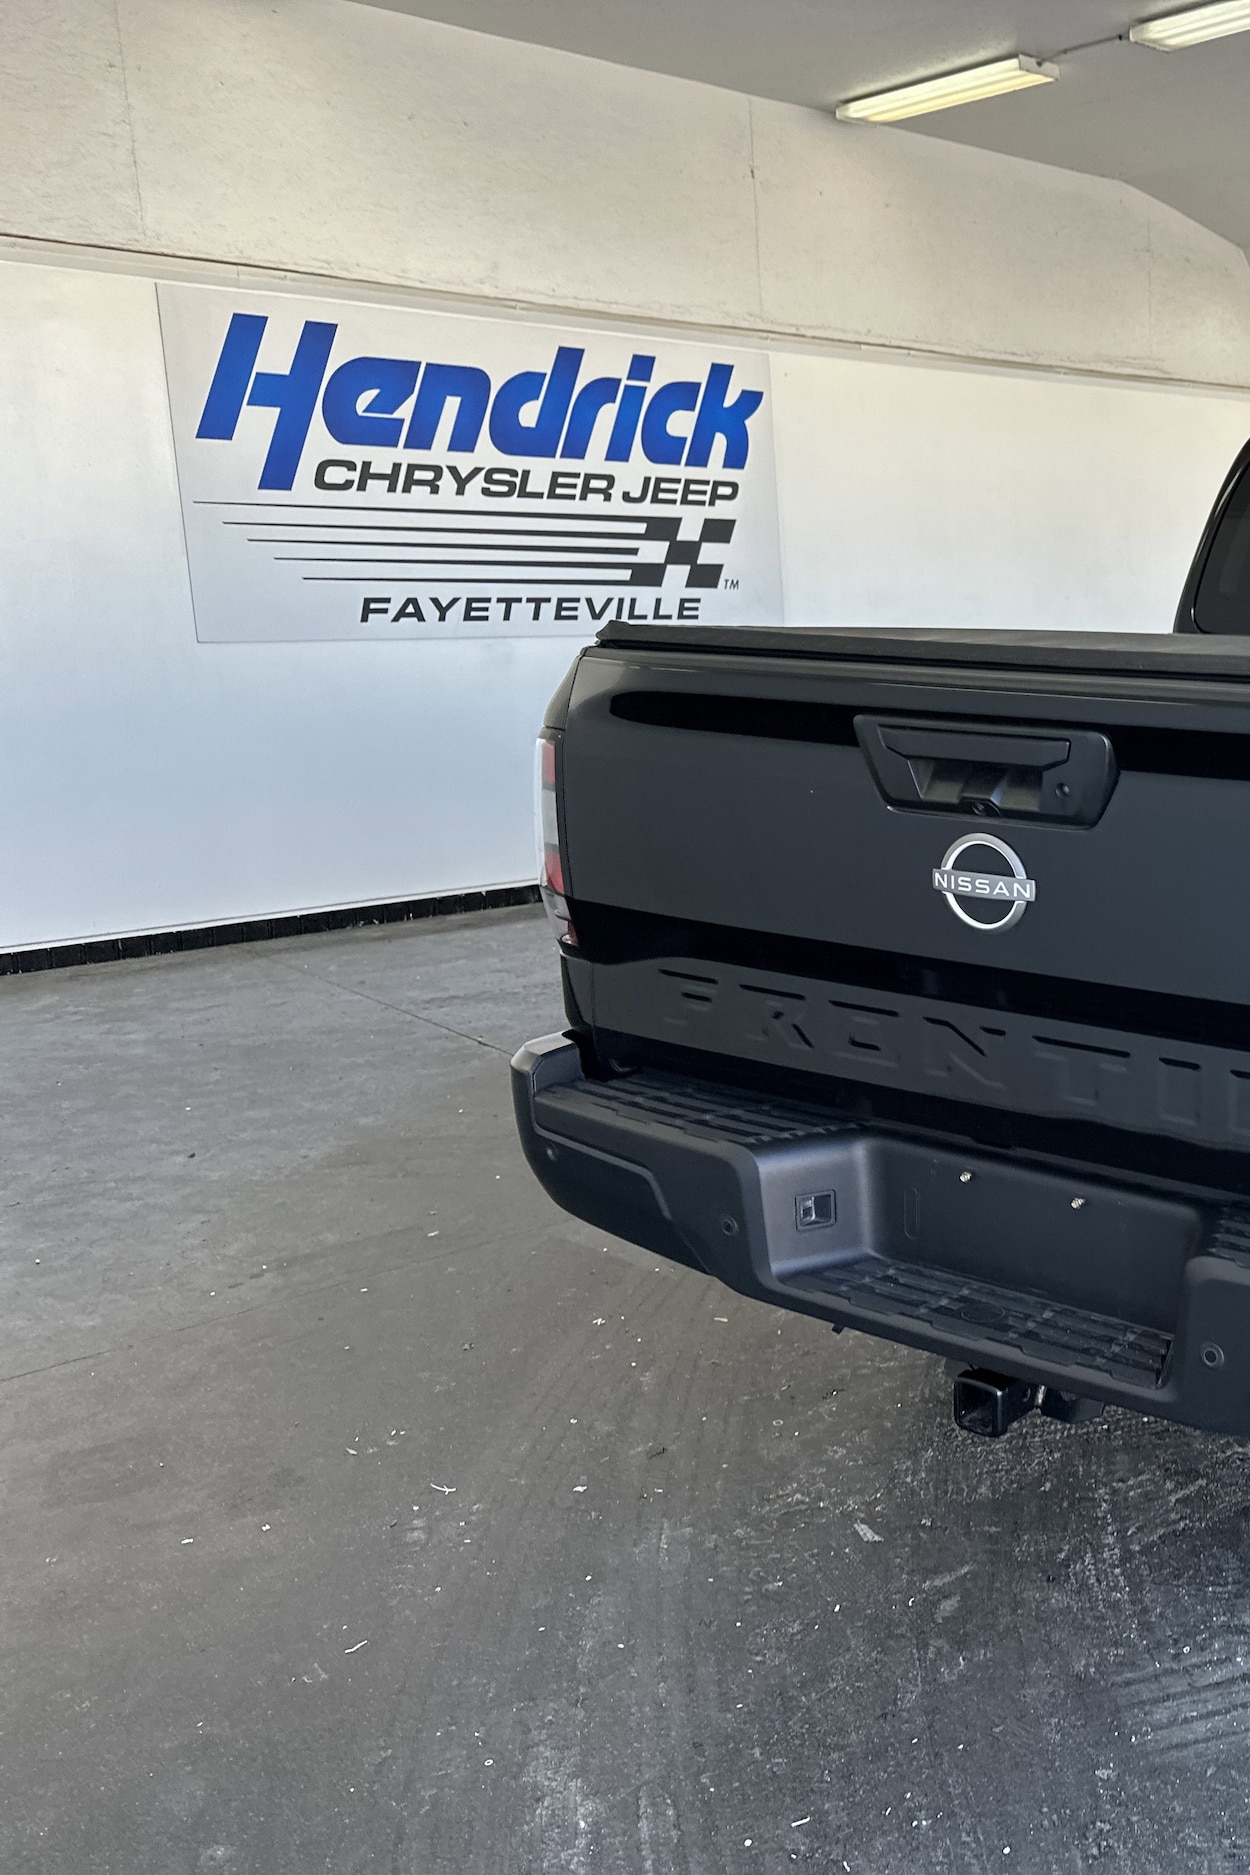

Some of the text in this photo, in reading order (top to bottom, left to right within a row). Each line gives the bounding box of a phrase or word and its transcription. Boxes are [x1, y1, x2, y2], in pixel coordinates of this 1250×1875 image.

[195, 312, 764, 491] Hendrick
[313, 458, 740, 508] CHRYSLER JEEP
[724, 579, 740, 590] TM
[360, 596, 702, 623] FAYETTEVILLE
[934, 872, 1031, 898] NISSAN
